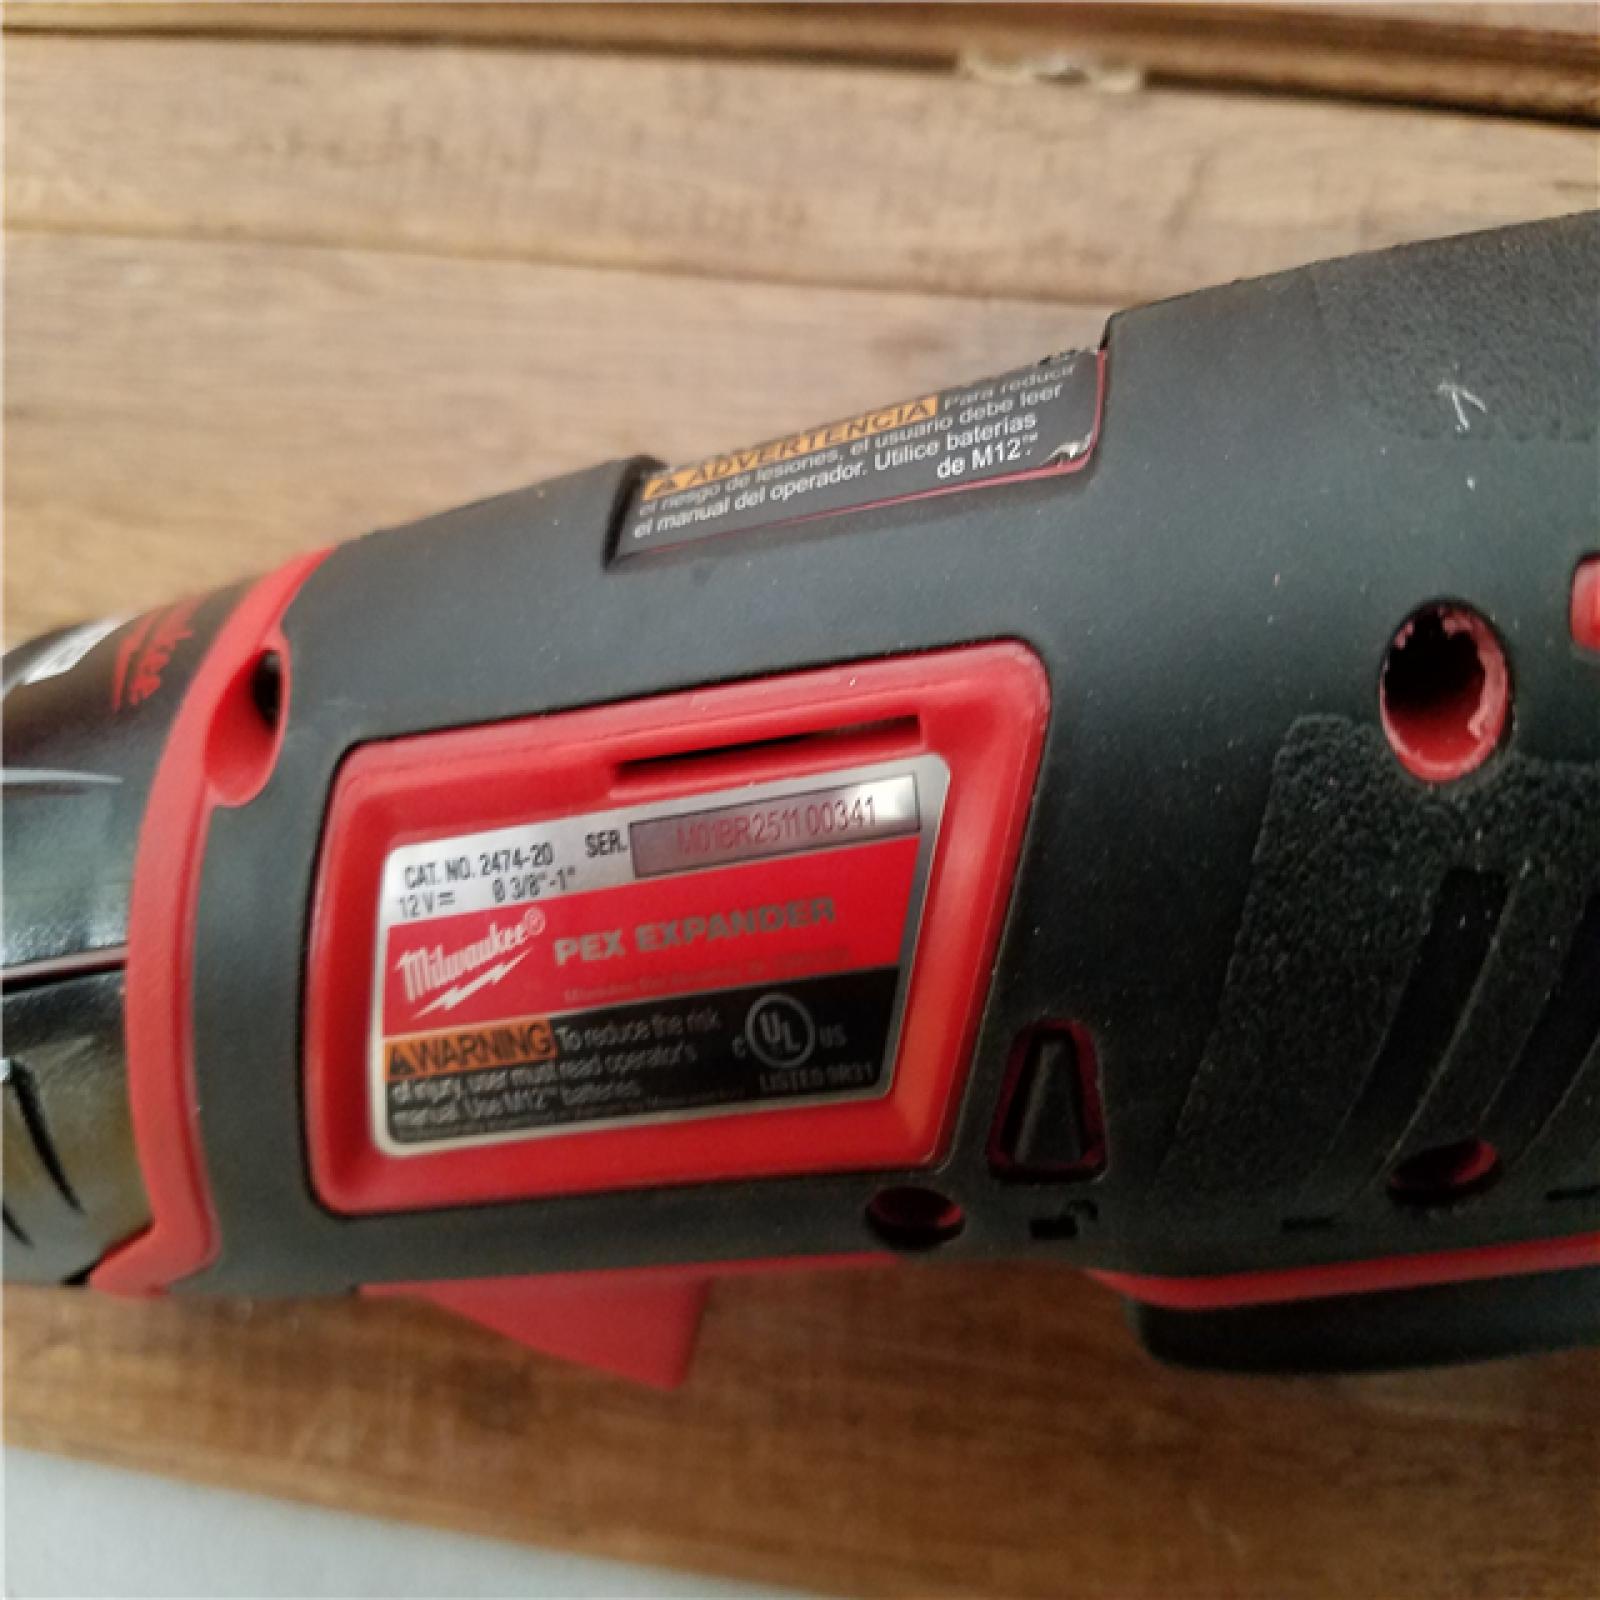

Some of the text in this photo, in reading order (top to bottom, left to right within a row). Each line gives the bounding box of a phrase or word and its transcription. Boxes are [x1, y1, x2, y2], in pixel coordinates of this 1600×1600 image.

[851, 435, 870, 457] el
[873, 414, 954, 449] usuario
[959, 398, 1014, 426] debe
[1019, 382, 1064, 408] leer
[633, 518, 654, 539] el
[657, 495, 731, 532] manual
[733, 485, 766, 512] del
[769, 459, 869, 502] operador.
[873, 438, 941, 472] Utilice
[936, 454, 967, 480] de
[445, 855, 476, 883] NO.
[479, 840, 554, 877] 2474-20
[584, 829, 629, 859] SER.
[553, 896, 837, 968] PEX EXPANDER
[412, 1022, 552, 1072] WARNING
[555, 1025, 584, 1052] To
[584, 1018, 650, 1048] reduce
